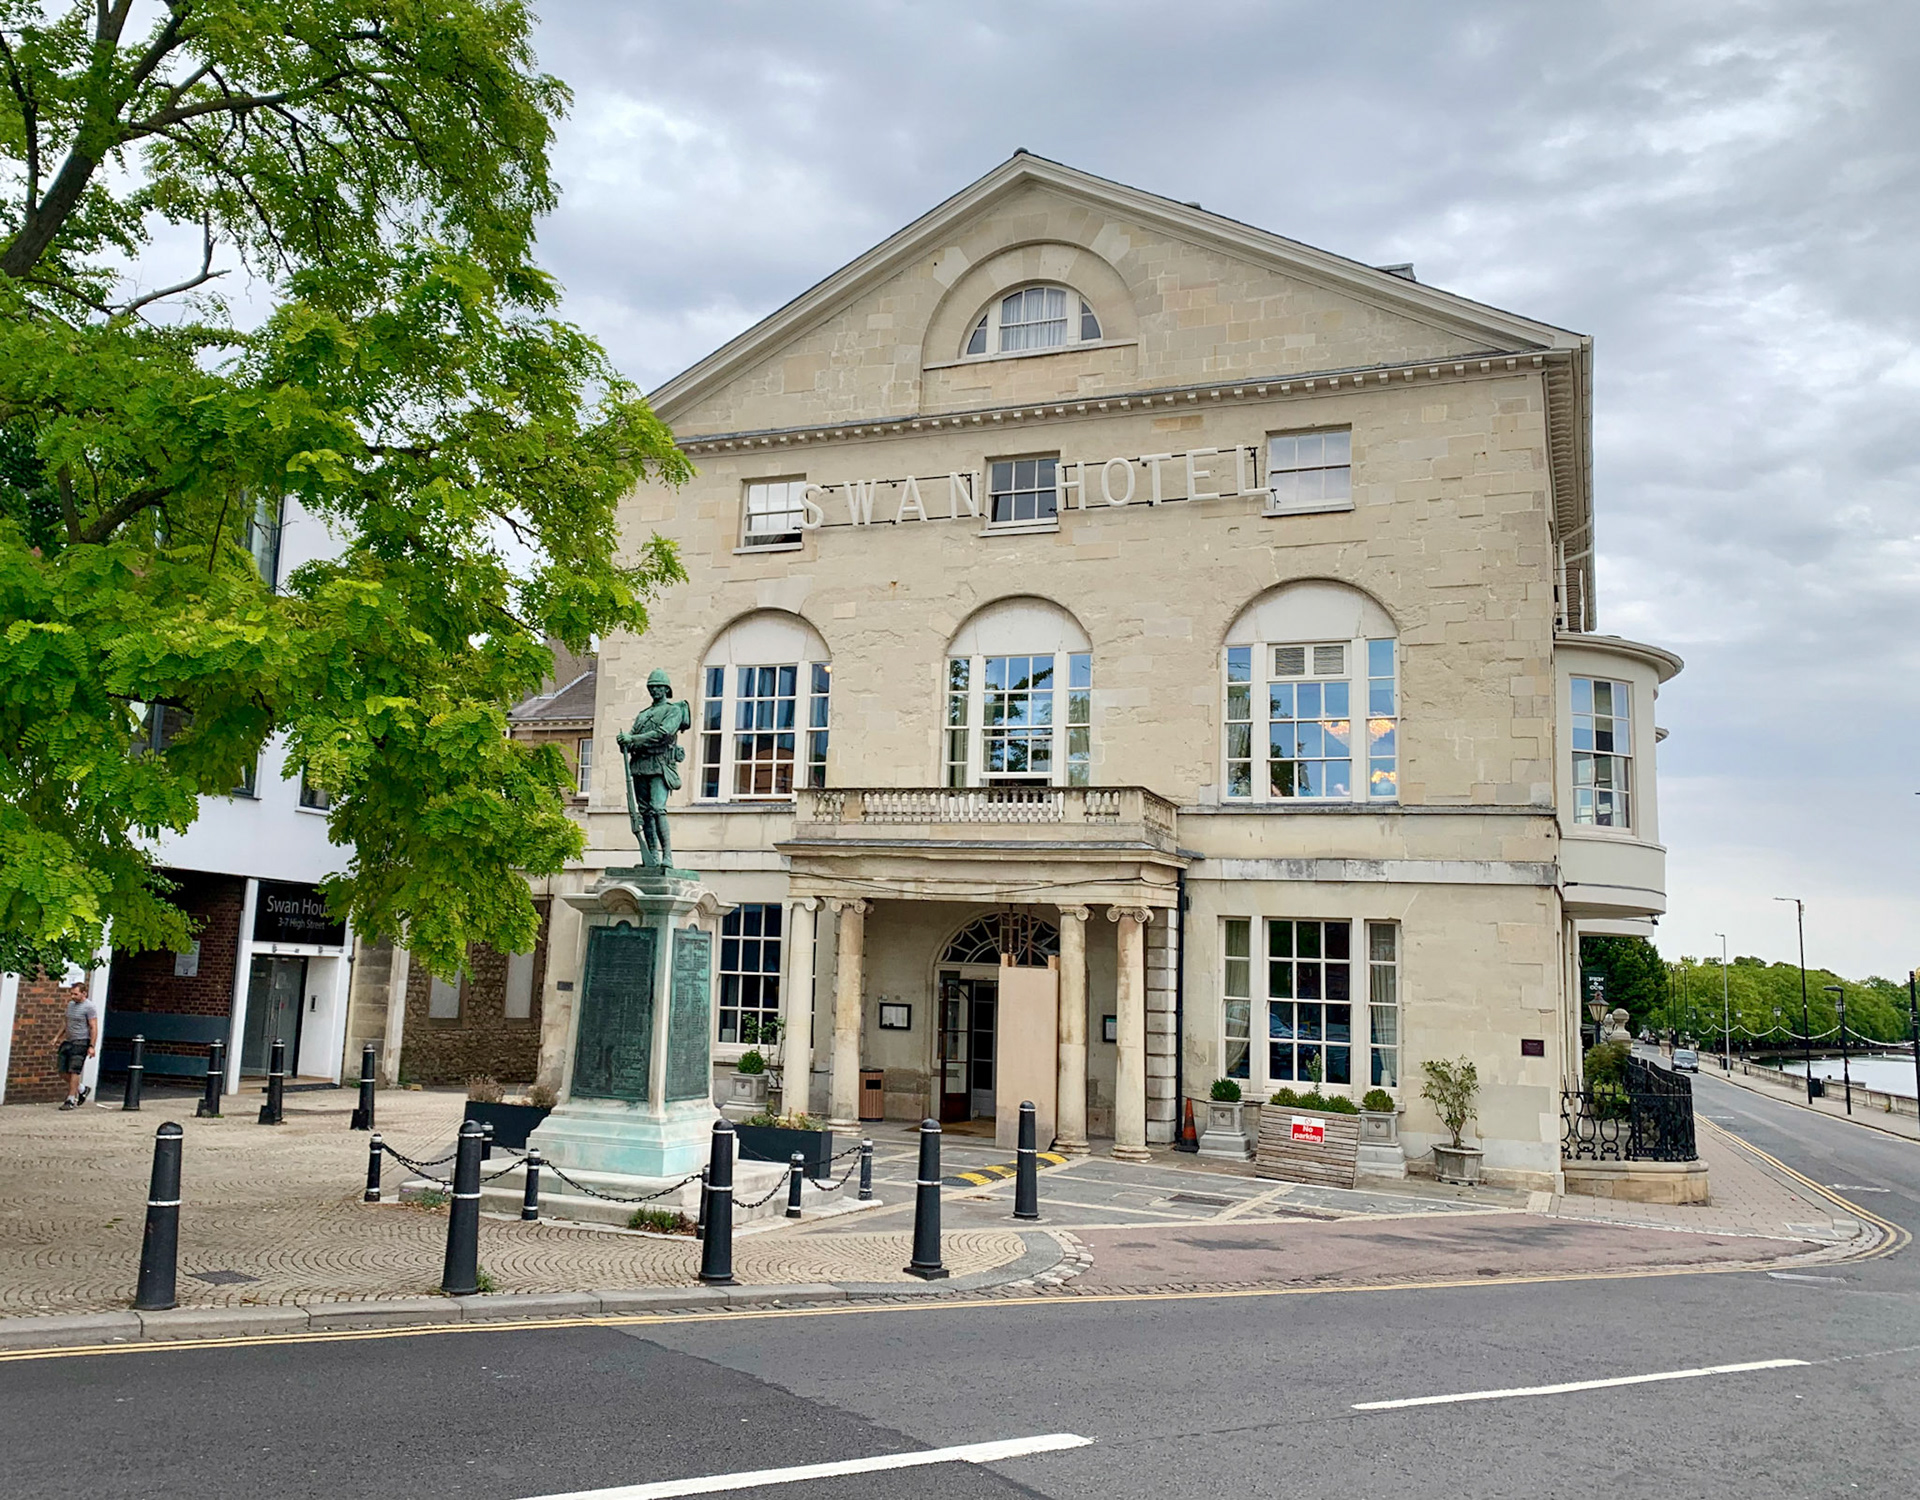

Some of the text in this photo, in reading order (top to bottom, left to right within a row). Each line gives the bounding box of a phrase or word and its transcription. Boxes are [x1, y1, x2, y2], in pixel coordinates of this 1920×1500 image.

[799, 445, 1270, 531] SWAN HOTEL
[266, 895, 331, 916] Swan Hou
[278, 917, 325, 930] 3-7 High Street
[1294, 1132, 1322, 1142] parking
